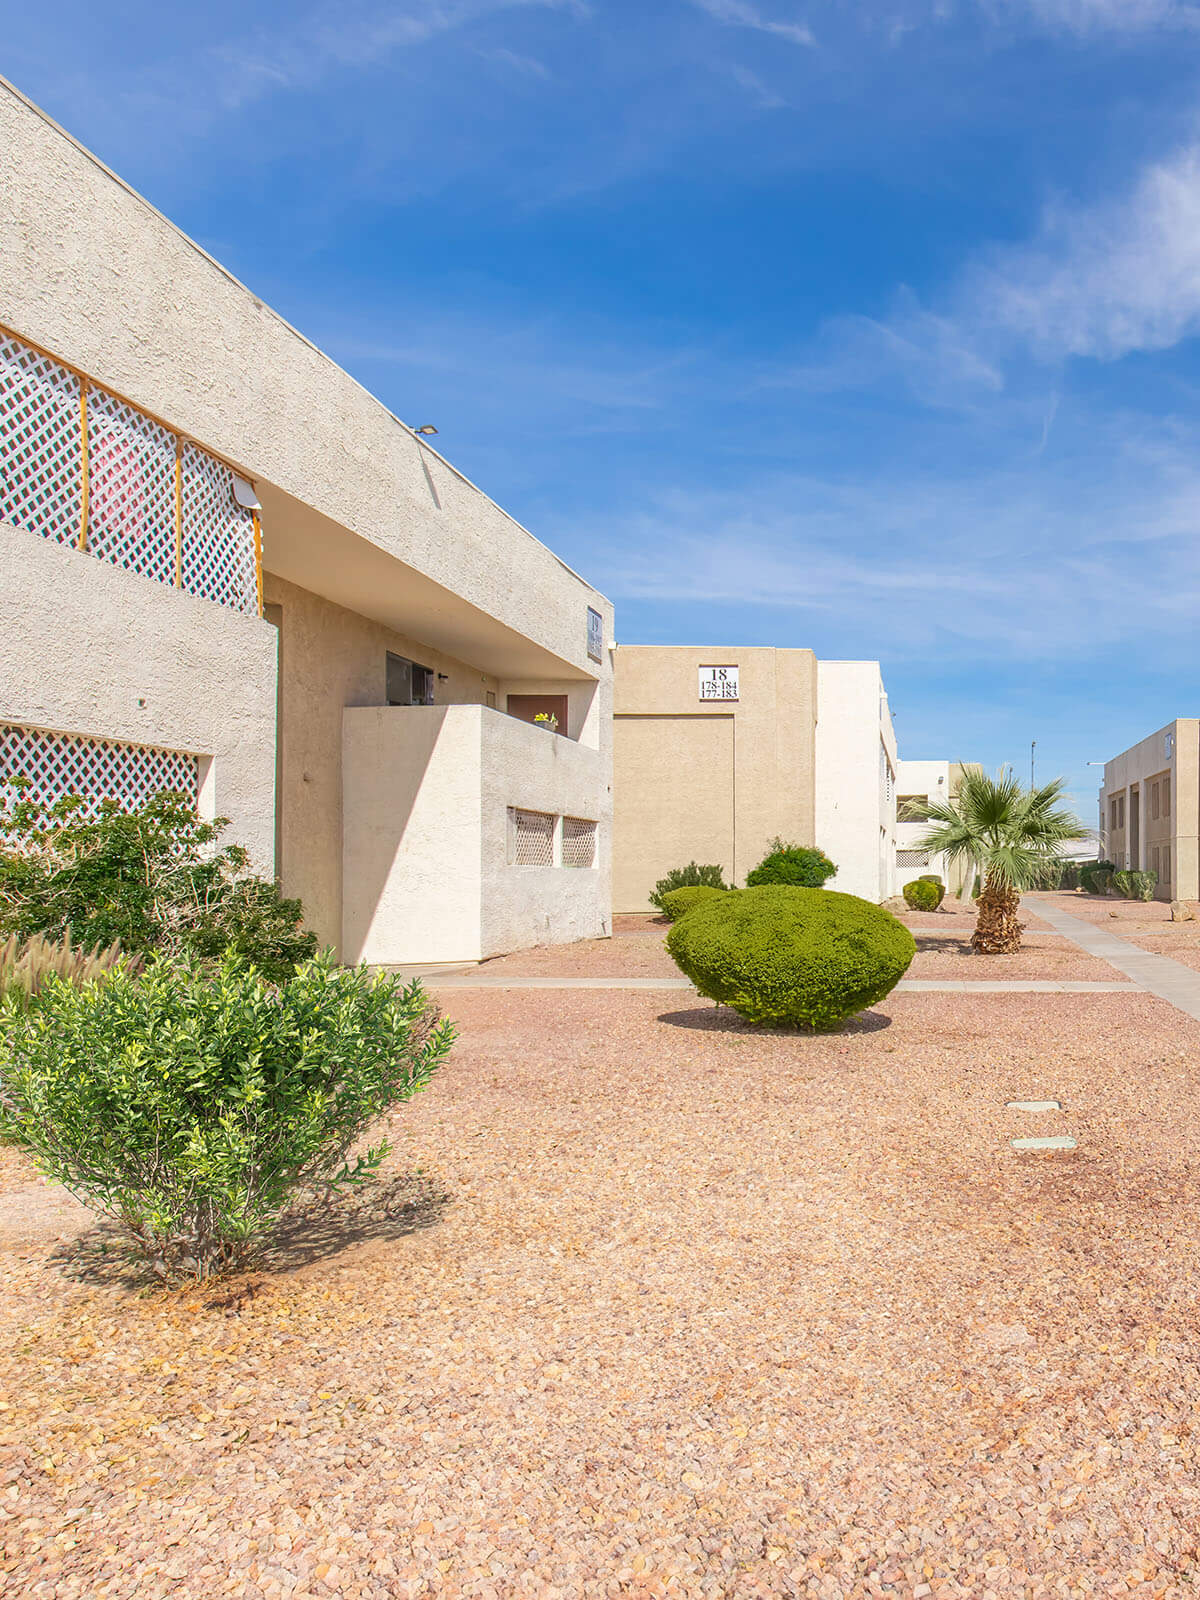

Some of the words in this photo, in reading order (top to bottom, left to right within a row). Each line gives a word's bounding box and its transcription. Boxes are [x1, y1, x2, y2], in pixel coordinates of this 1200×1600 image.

[712, 669, 727, 680] 18
[702, 681, 737, 690] 178-184
[702, 690, 737, 698] 177-183
